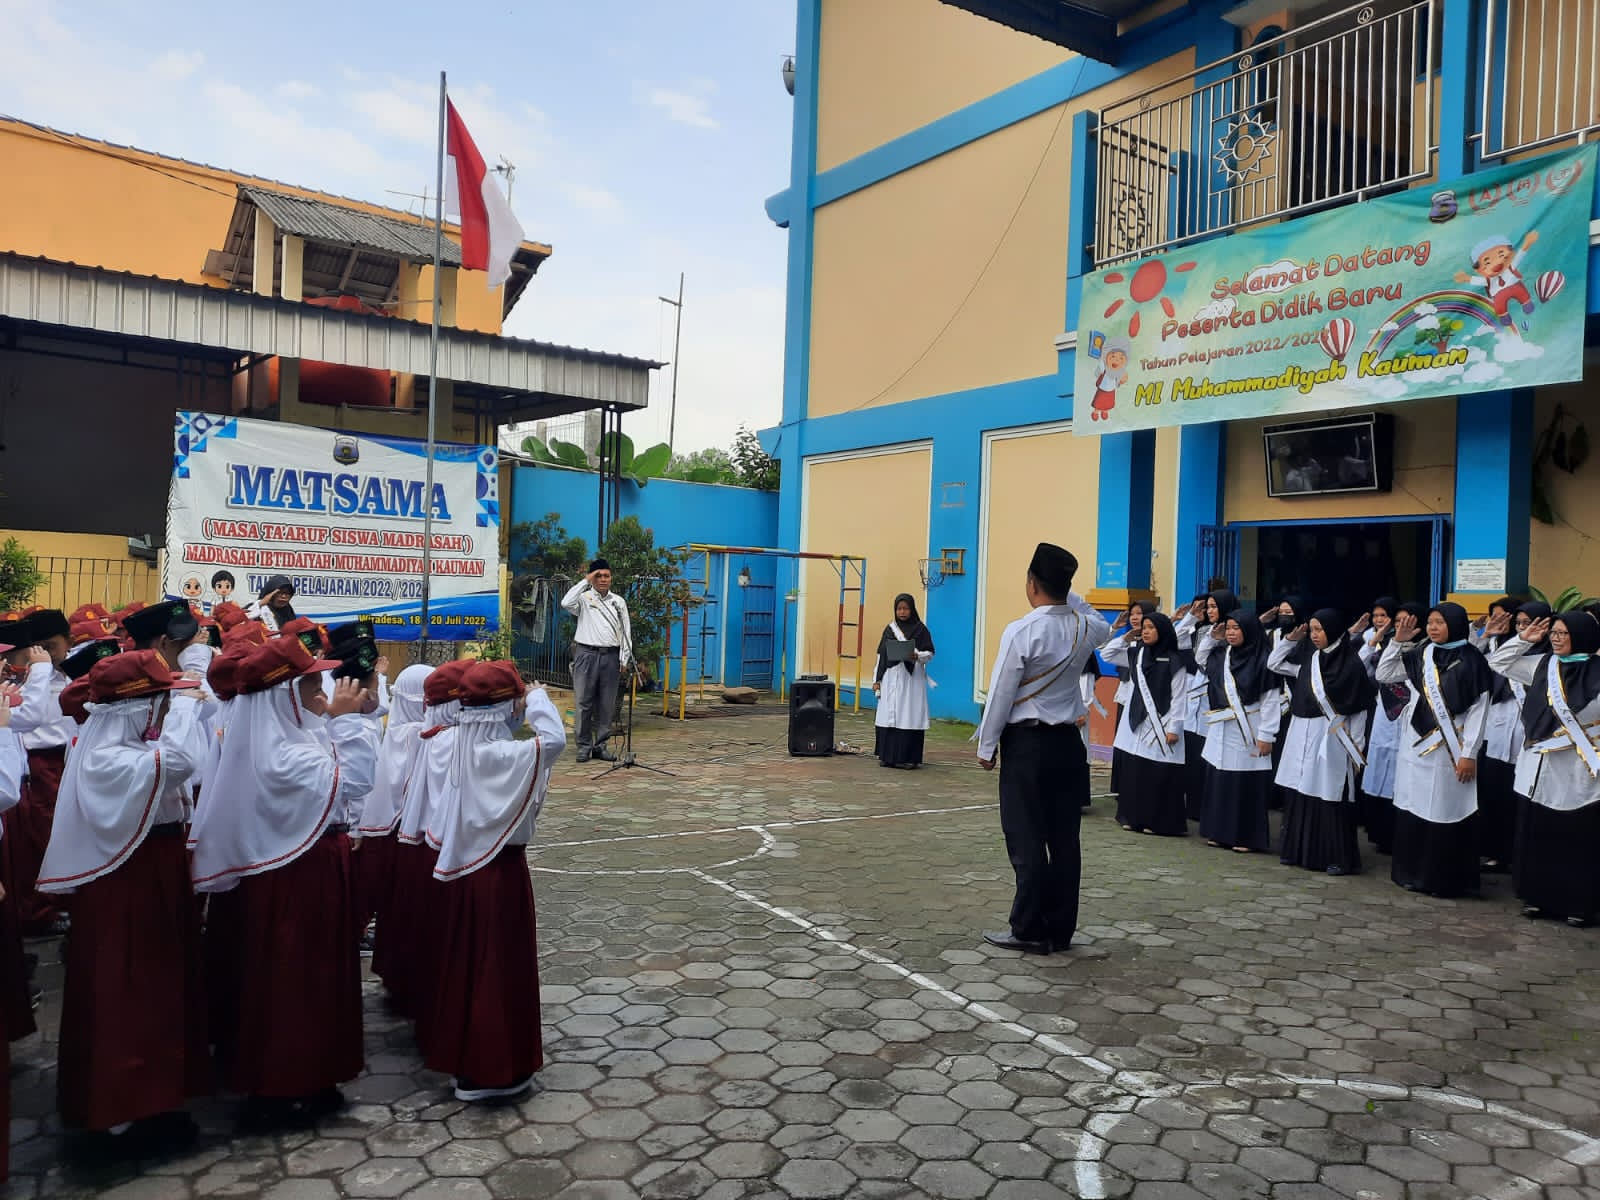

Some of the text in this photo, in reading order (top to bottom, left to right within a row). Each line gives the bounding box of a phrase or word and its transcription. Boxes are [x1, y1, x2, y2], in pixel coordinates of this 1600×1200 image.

[1211, 240, 1431, 299] Selamat Datang
[1161, 282, 1403, 341] Peserta Didik Baru
[1140, 355, 1177, 371] Tahun
[1179, 342, 1243, 365] Pelajaran
[1135, 348, 1469, 407] MI Muhammadiyah Kauman
[231, 463, 453, 521] MATSAMA
[263, 524, 328, 543] TA'ARUF
[332, 529, 379, 546] SISWA
[185, 545, 256, 566] MADRASAH
[260, 550, 331, 569] IBTIDAIYAH
[435, 559, 484, 575] KAUMAN
[293, 577, 359, 596] PELAJARAN
[410, 615, 421, 625] 18
[431, 615, 442, 625] 20
[445, 615, 461, 625] Juli
[464, 616, 486, 626] 2022
